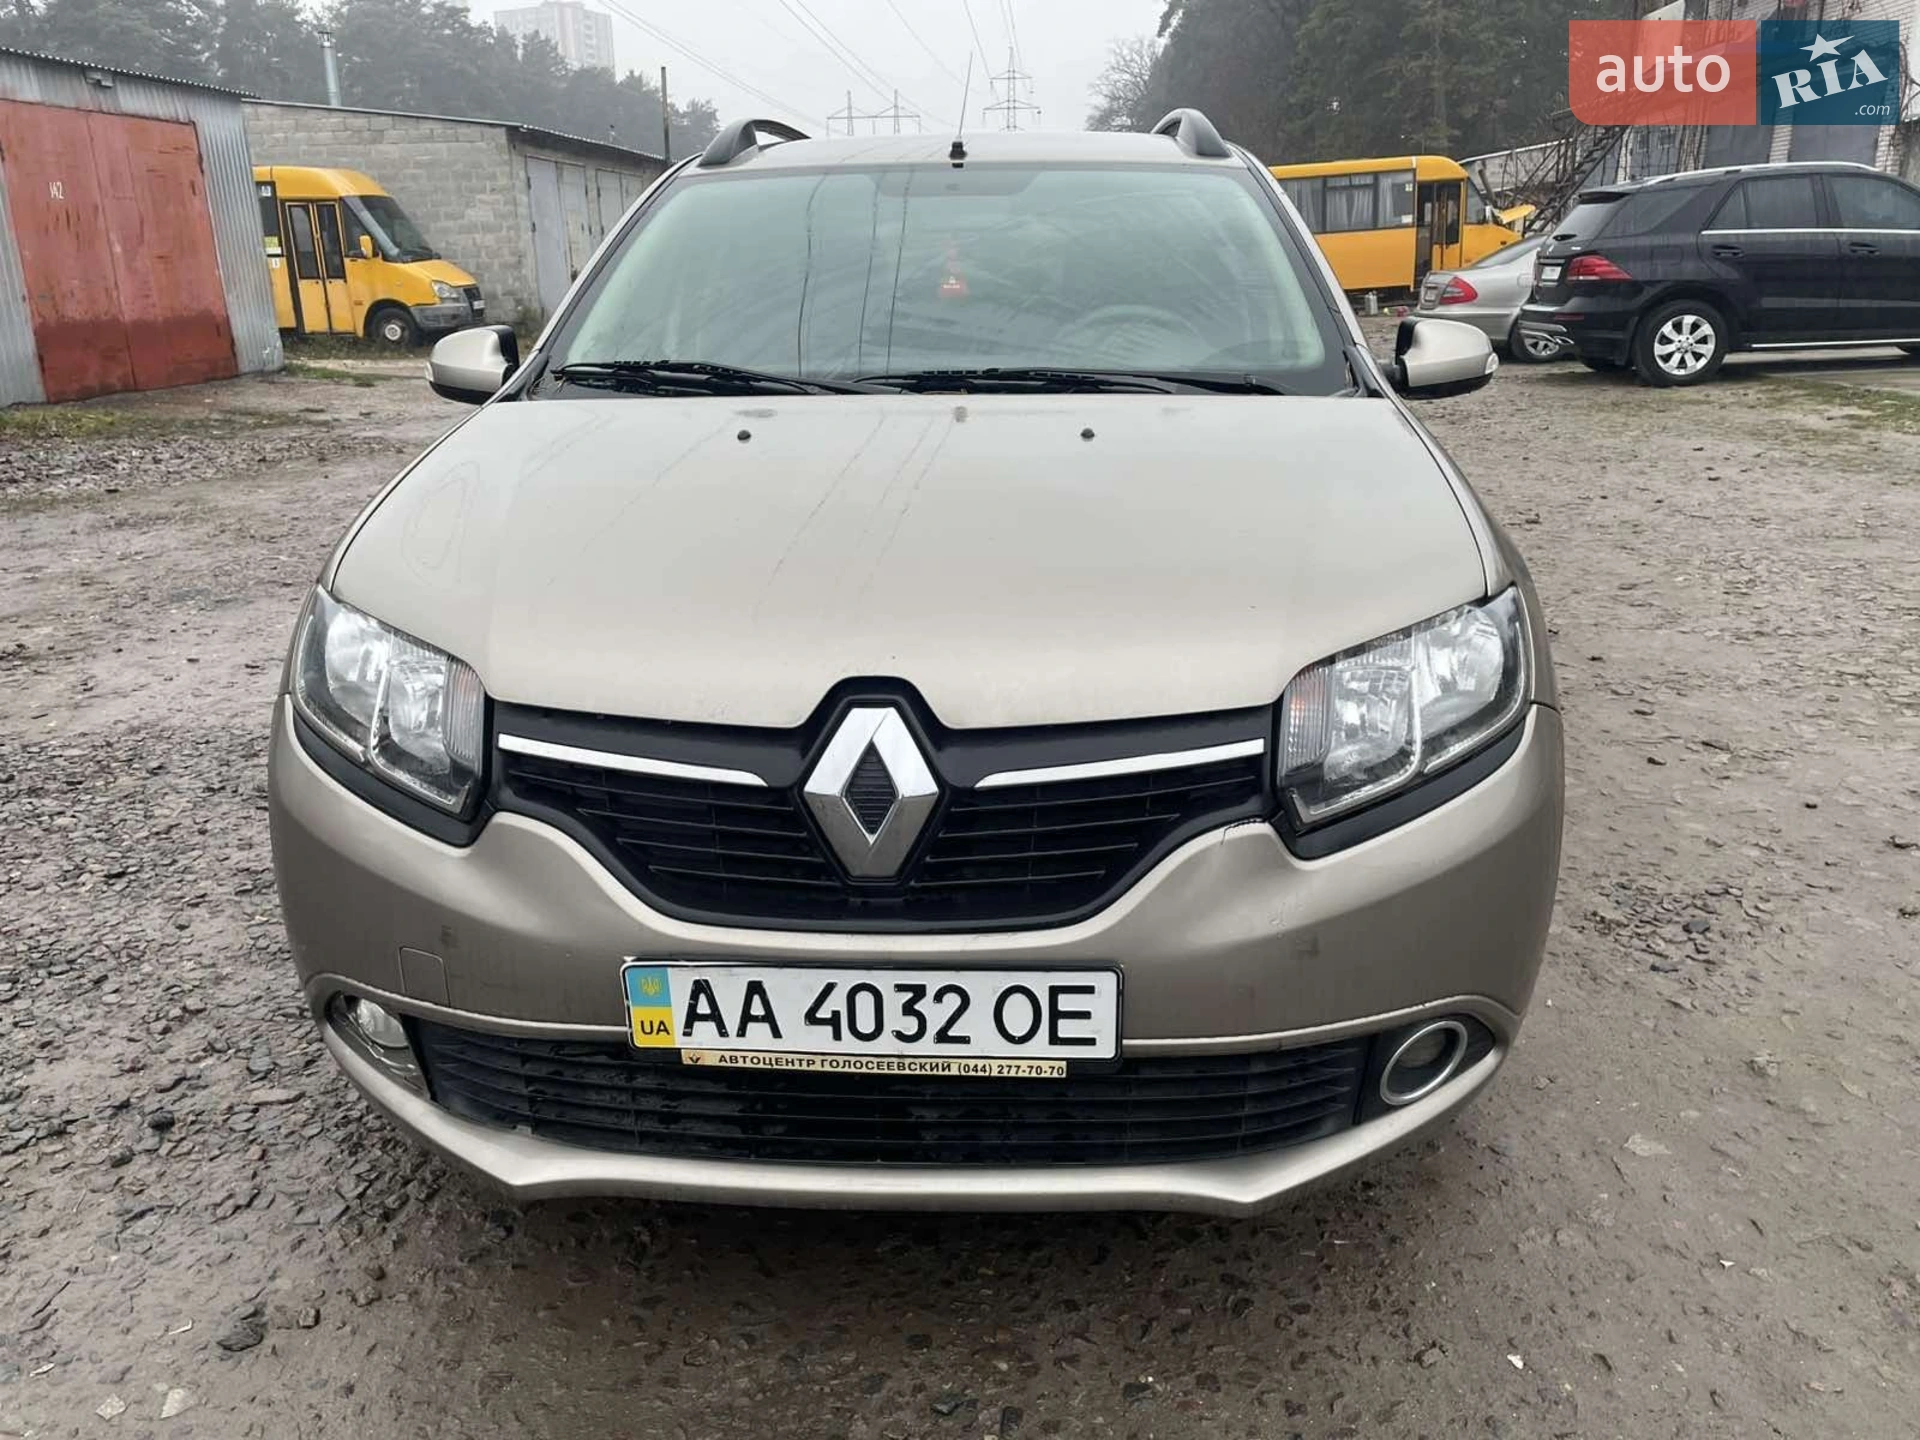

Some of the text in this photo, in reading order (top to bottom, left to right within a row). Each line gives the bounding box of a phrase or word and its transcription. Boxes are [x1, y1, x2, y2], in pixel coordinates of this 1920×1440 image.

[682, 978, 1097, 1046] AA 4032 OE
[640, 1020, 670, 1036] UA
[718, 1054, 1065, 1077] АВТОЦЕНТР ГОЛОСЕЕВСКИЙ (044) 277-70-70
